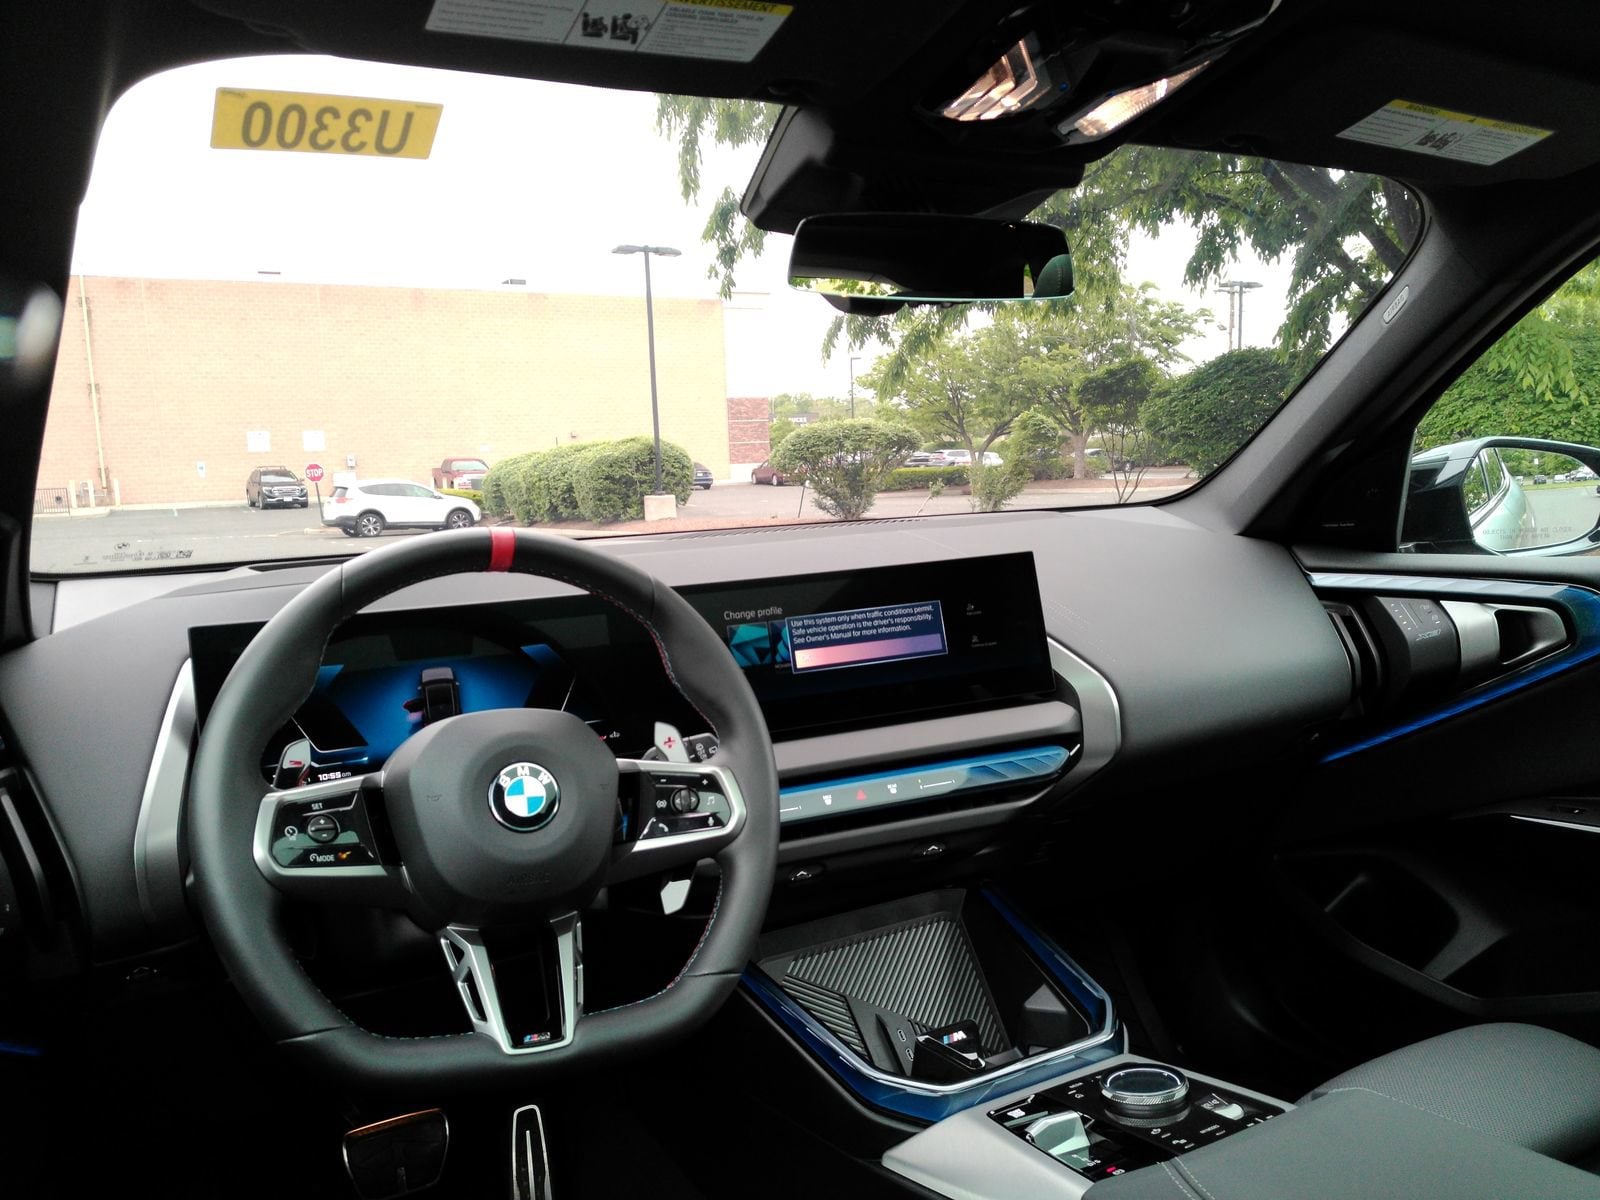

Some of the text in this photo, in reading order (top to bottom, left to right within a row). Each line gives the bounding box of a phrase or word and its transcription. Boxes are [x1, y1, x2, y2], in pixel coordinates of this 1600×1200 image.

[306, 468, 323, 478] STOP
[724, 606, 783, 621] Change profile
[791, 619, 803, 627] Use
[815, 617, 837, 627] system
[837, 614, 850, 623] only
[850, 612, 866, 620] when
[866, 610, 882, 618] traffic
[883, 607, 914, 616] conditions
[792, 628, 806, 636] Safe
[806, 625, 828, 635] vehicle
[828, 622, 856, 633] operation
[862, 619, 873, 627] the
[873, 617, 894, 626] driver's
[793, 636, 805, 644] See
[805, 634, 830, 643] Owner's
[830, 630, 852, 639] Manual
[852, 629, 861, 637] for
[861, 628, 877, 636] more
[318, 771, 342, 781] 10:55
[499, 766, 552, 788] BMW
[311, 802, 323, 810] SET
[316, 854, 335, 862] MODE
